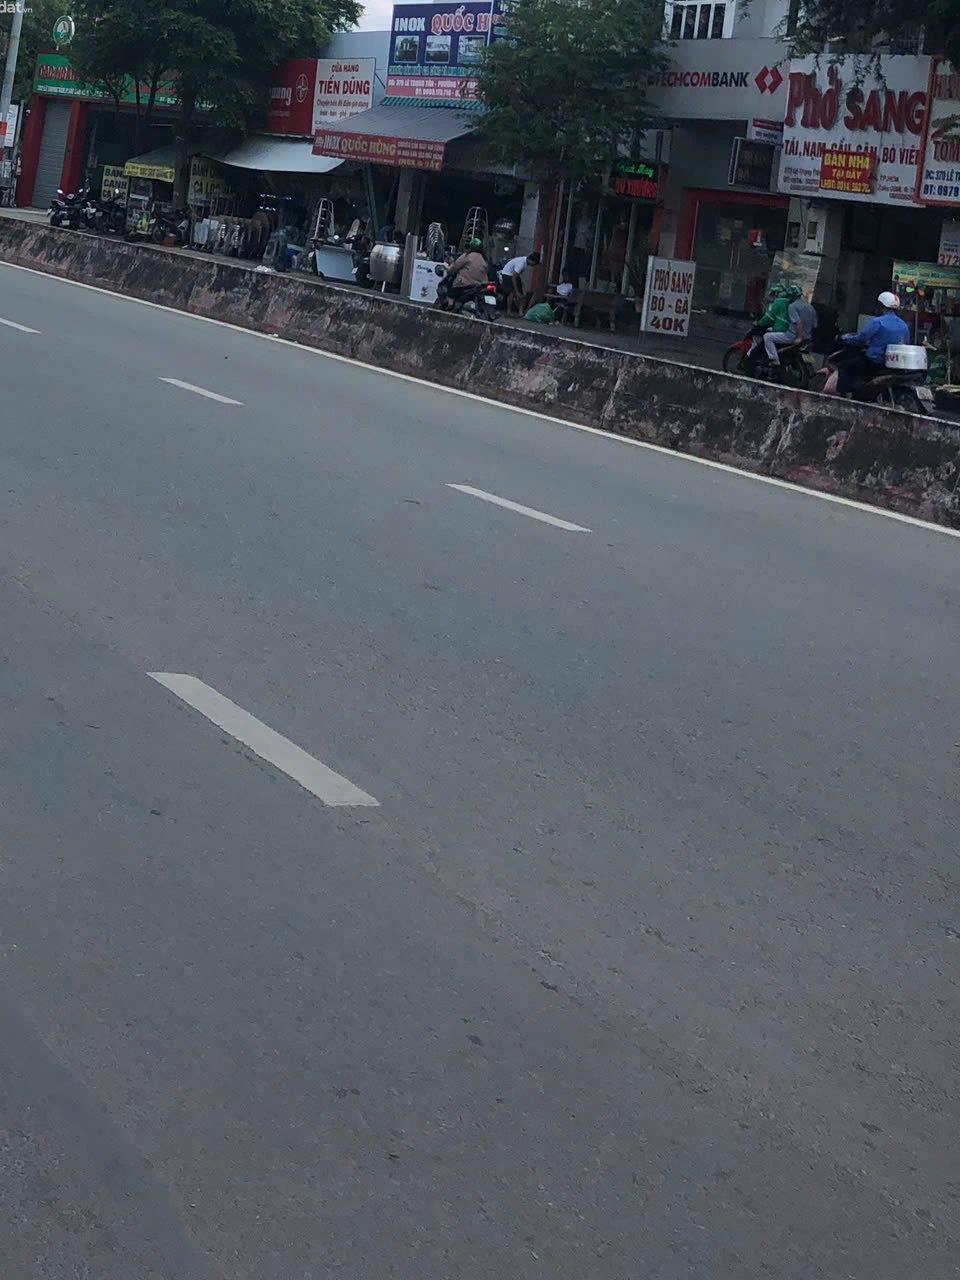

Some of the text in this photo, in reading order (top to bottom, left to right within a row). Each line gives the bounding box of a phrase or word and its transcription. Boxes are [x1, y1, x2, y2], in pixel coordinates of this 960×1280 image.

[394, 17, 426, 32] INOX
[431, 5, 474, 35] QUỐC
[318, 74, 370, 95] TIẾN DŨNG
[655, 71, 750, 88] TECHCOMBANK
[844, 88, 928, 135] SANG
[341, 136, 368, 153] QUỐC
[369, 139, 397, 156] HÙNG
[653, 261, 693, 294] PHỞ SANG
[651, 293, 665, 312] BÒ
[675, 295, 689, 315] GÀ
[650, 315, 685, 332] 40K
